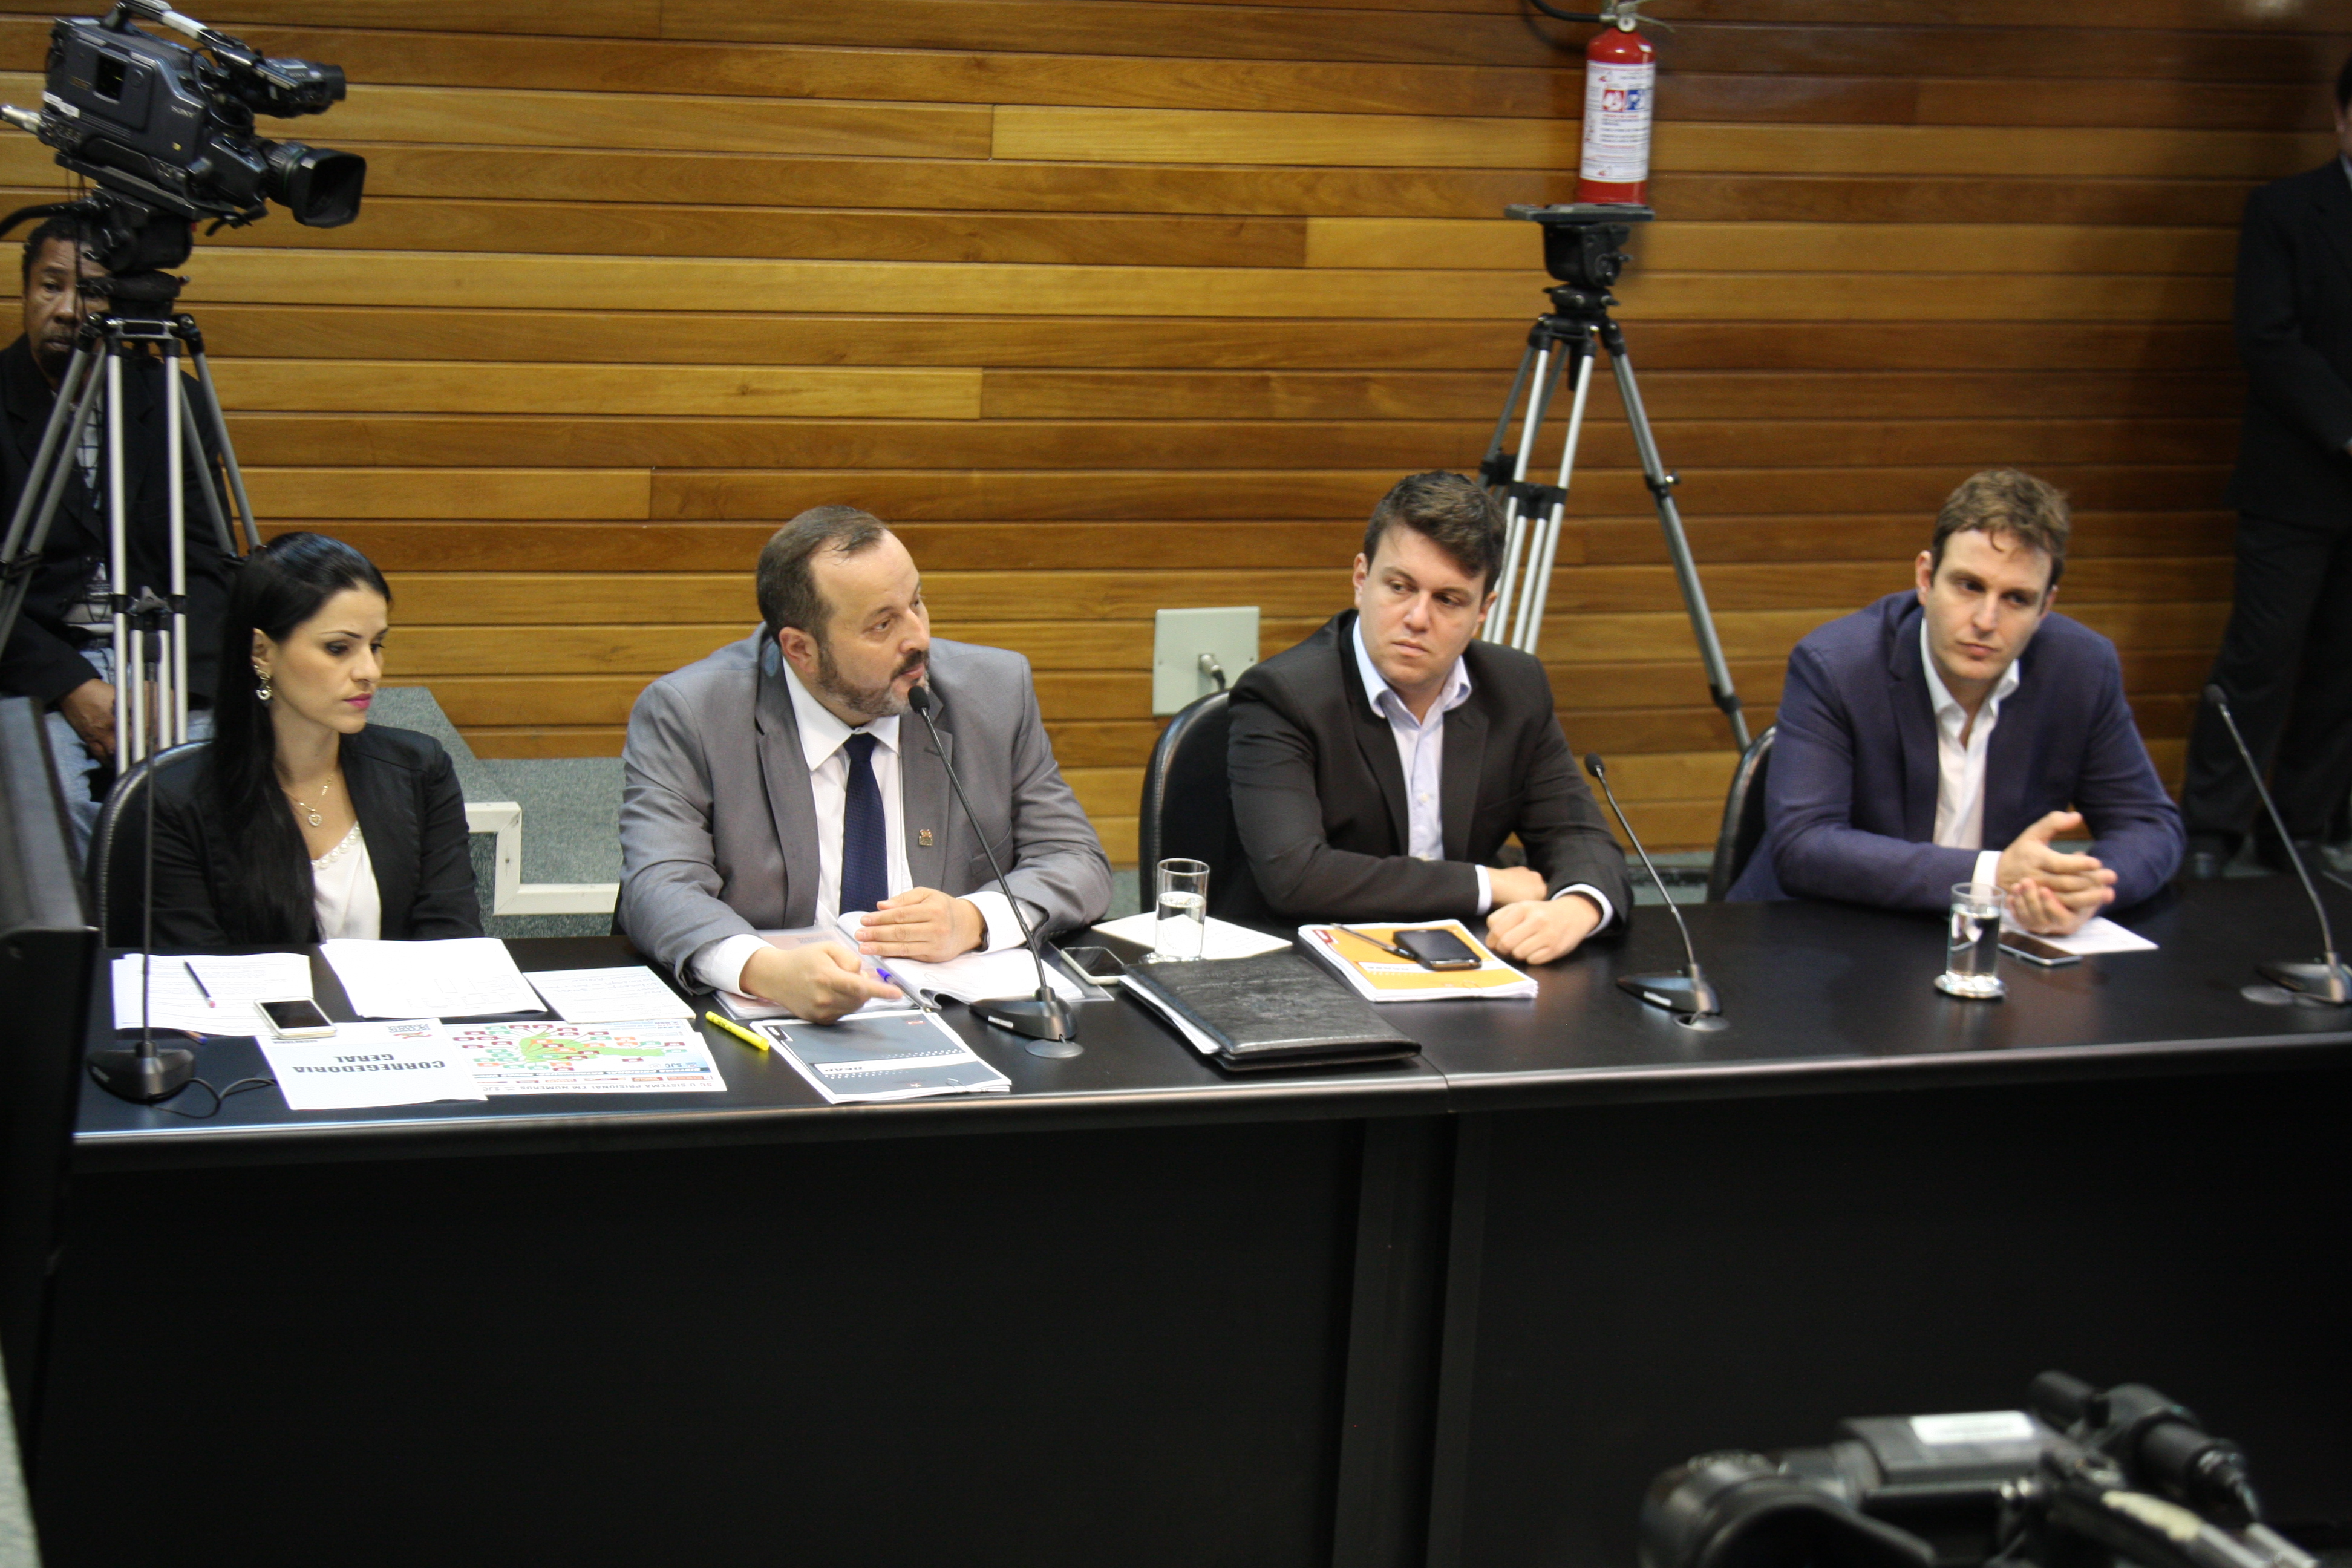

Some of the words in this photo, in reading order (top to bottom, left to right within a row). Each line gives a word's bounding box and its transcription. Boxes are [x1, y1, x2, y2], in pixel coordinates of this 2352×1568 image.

[171, 105, 196, 119] SONY
[333, 1054, 394, 1063] GERAL
[292, 1061, 445, 1073] CORREGEDORIA
